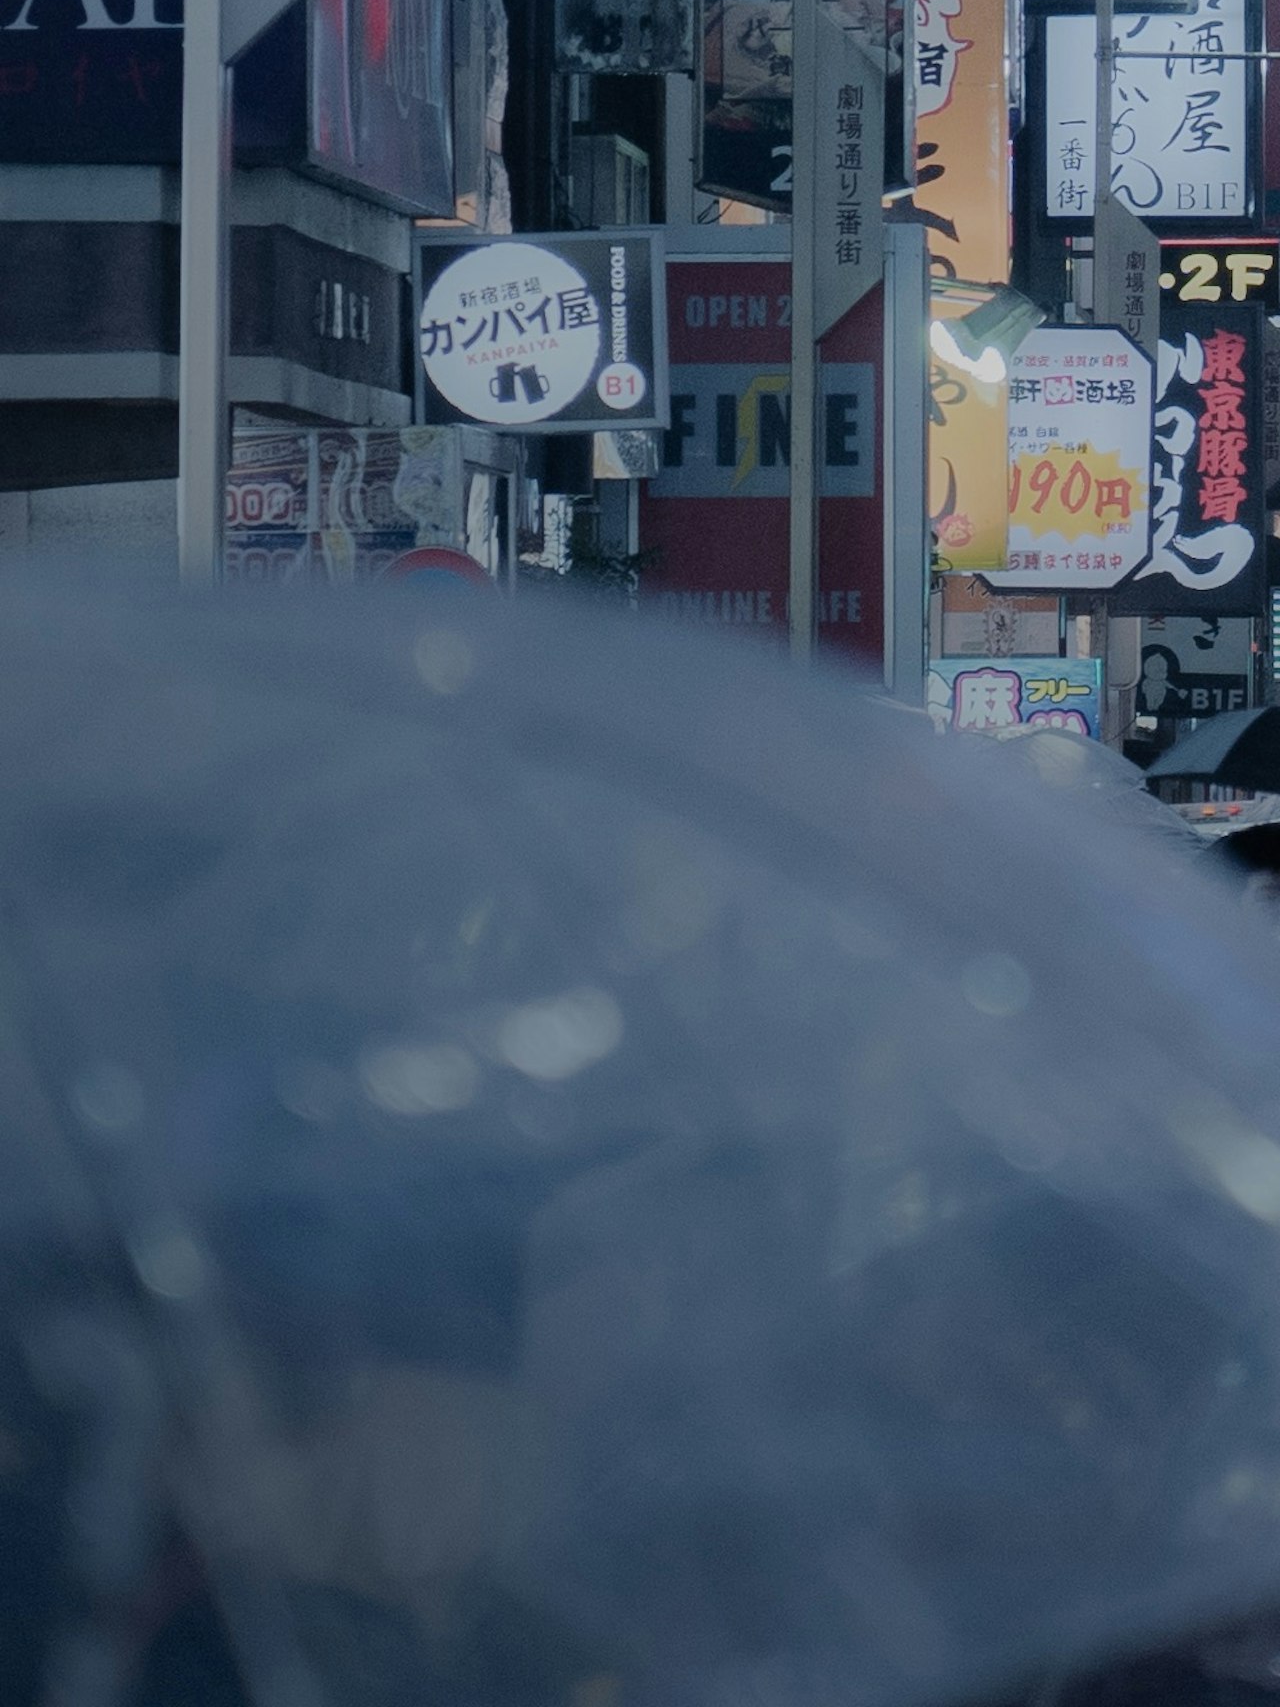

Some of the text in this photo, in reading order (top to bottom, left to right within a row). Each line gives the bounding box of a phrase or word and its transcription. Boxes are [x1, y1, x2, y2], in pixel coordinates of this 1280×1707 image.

[835, 83, 865, 268] 劇場通り一番街
[1055, 118, 1090, 212] 一番街
[1176, 182, 1240, 211] B1F
[607, 245, 626, 290] FOOD
[457, 277, 542, 309] 新宿酒場
[419, 288, 600, 359] カンパイ屋
[608, 307, 627, 365] DRINKS
[466, 336, 561, 368] KANPAIYA
[605, 374, 638, 397] B1
[1197, 326, 1249, 525] 東京豚骨
[1023, 678, 1091, 703] フリー
[1189, 687, 1247, 711] B1F
